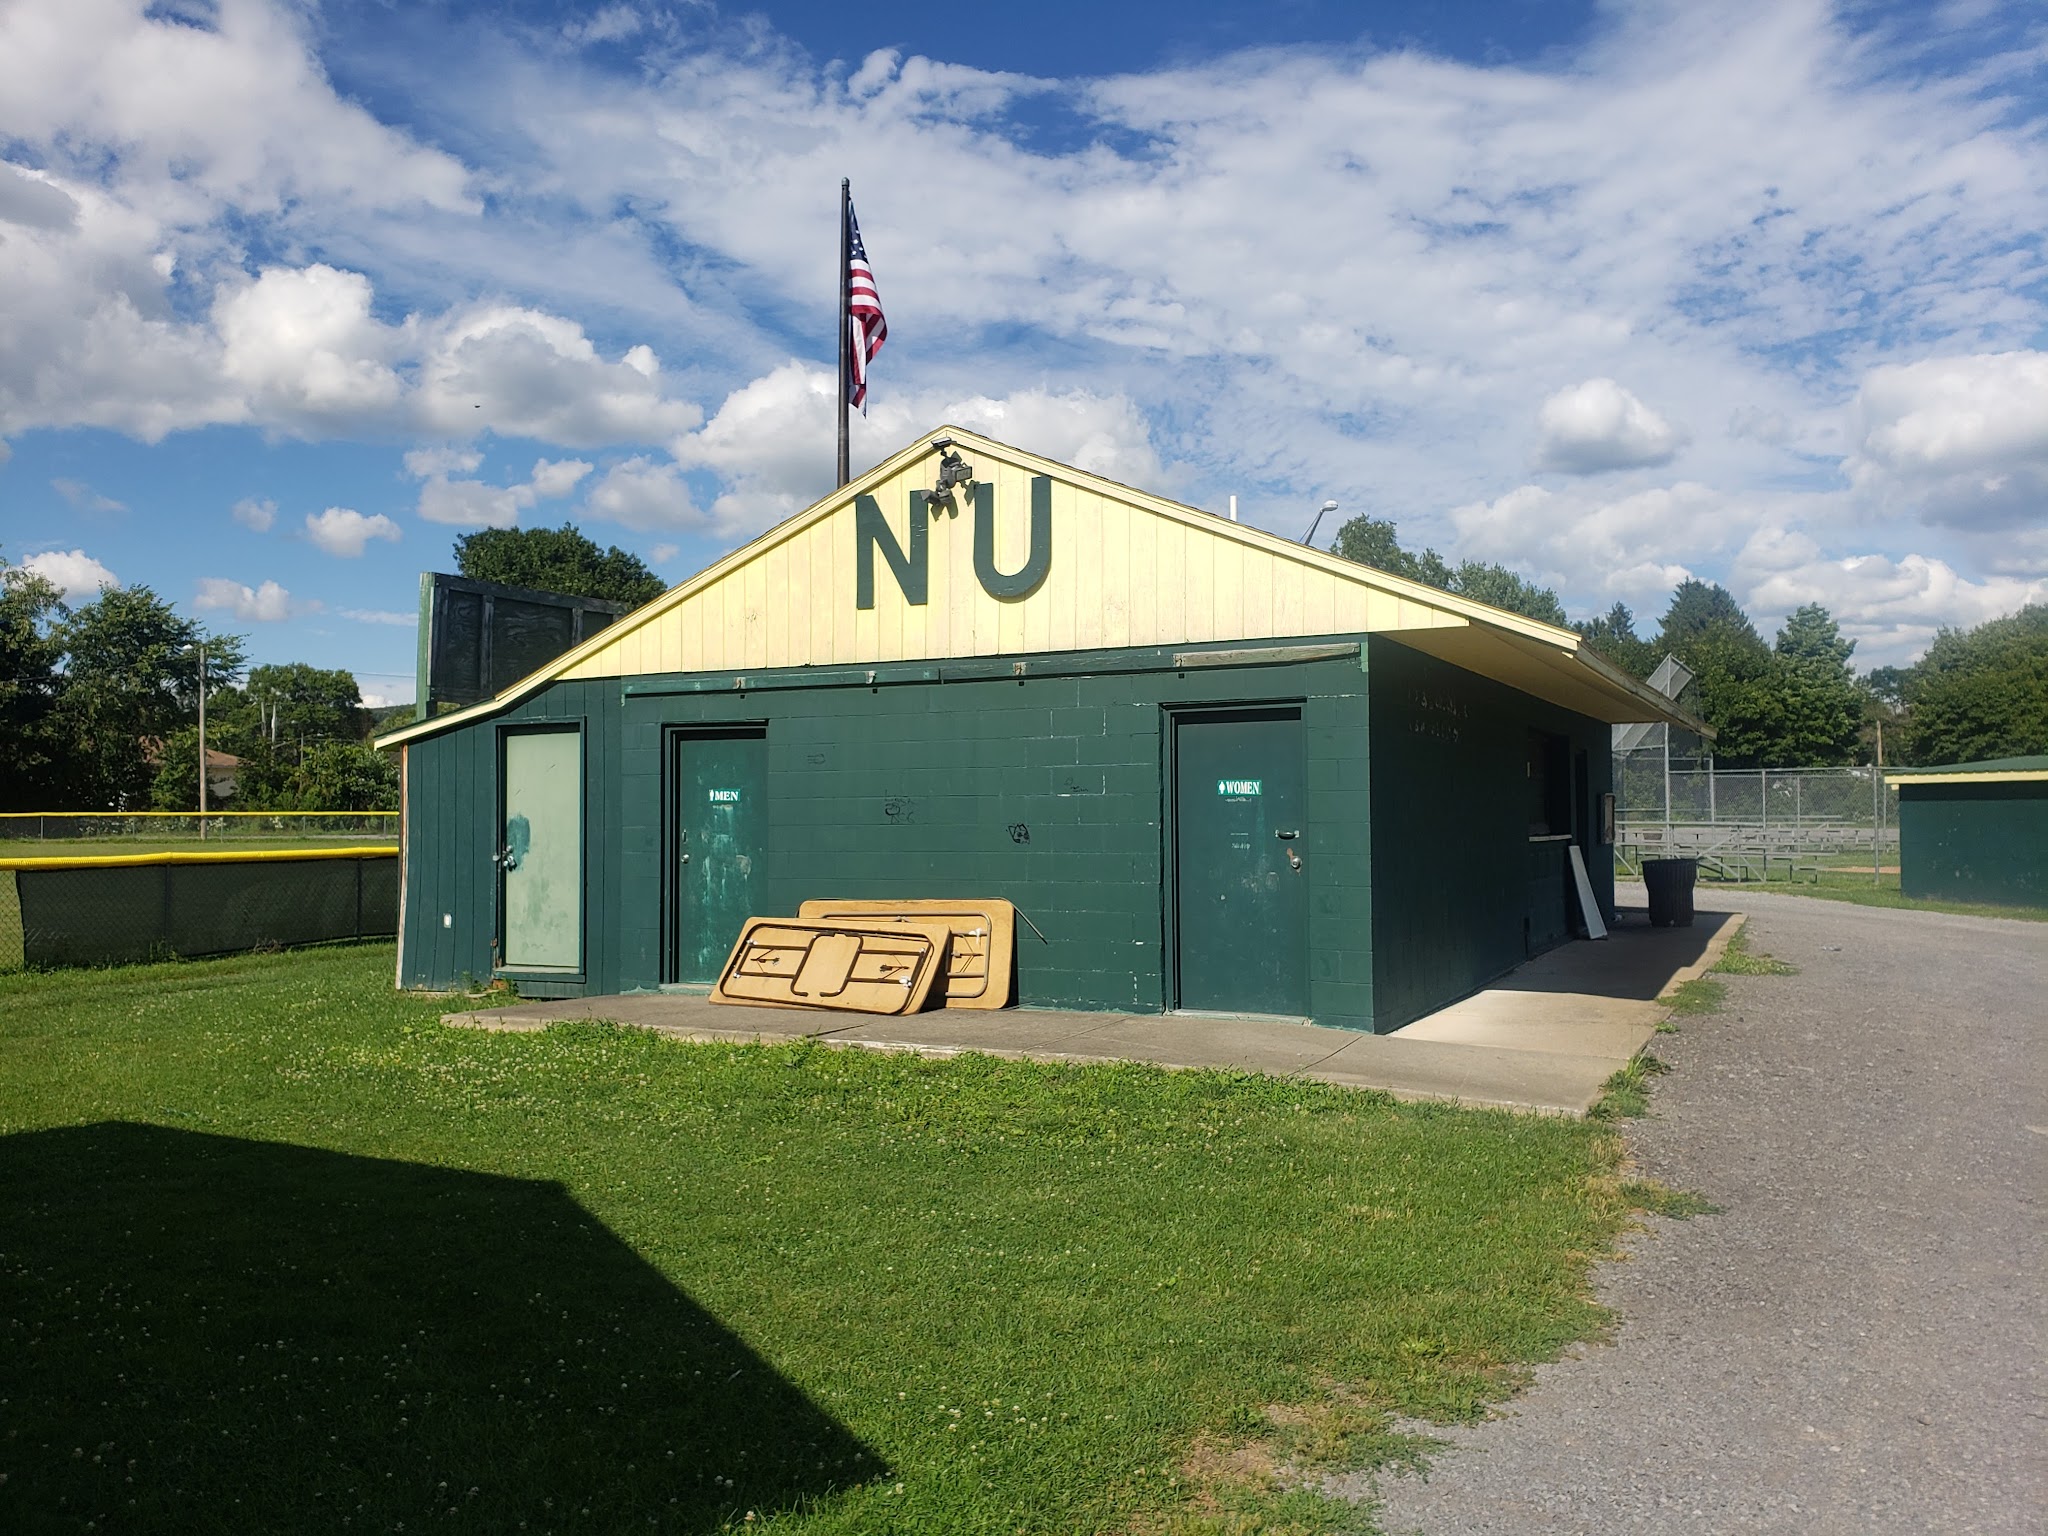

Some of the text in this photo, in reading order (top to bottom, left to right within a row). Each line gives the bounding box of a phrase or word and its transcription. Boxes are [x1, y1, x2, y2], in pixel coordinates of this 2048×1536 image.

[856, 475, 1051, 609] NU
[1226, 781, 1260, 794] WOMEN
[714, 790, 739, 801] MEN
